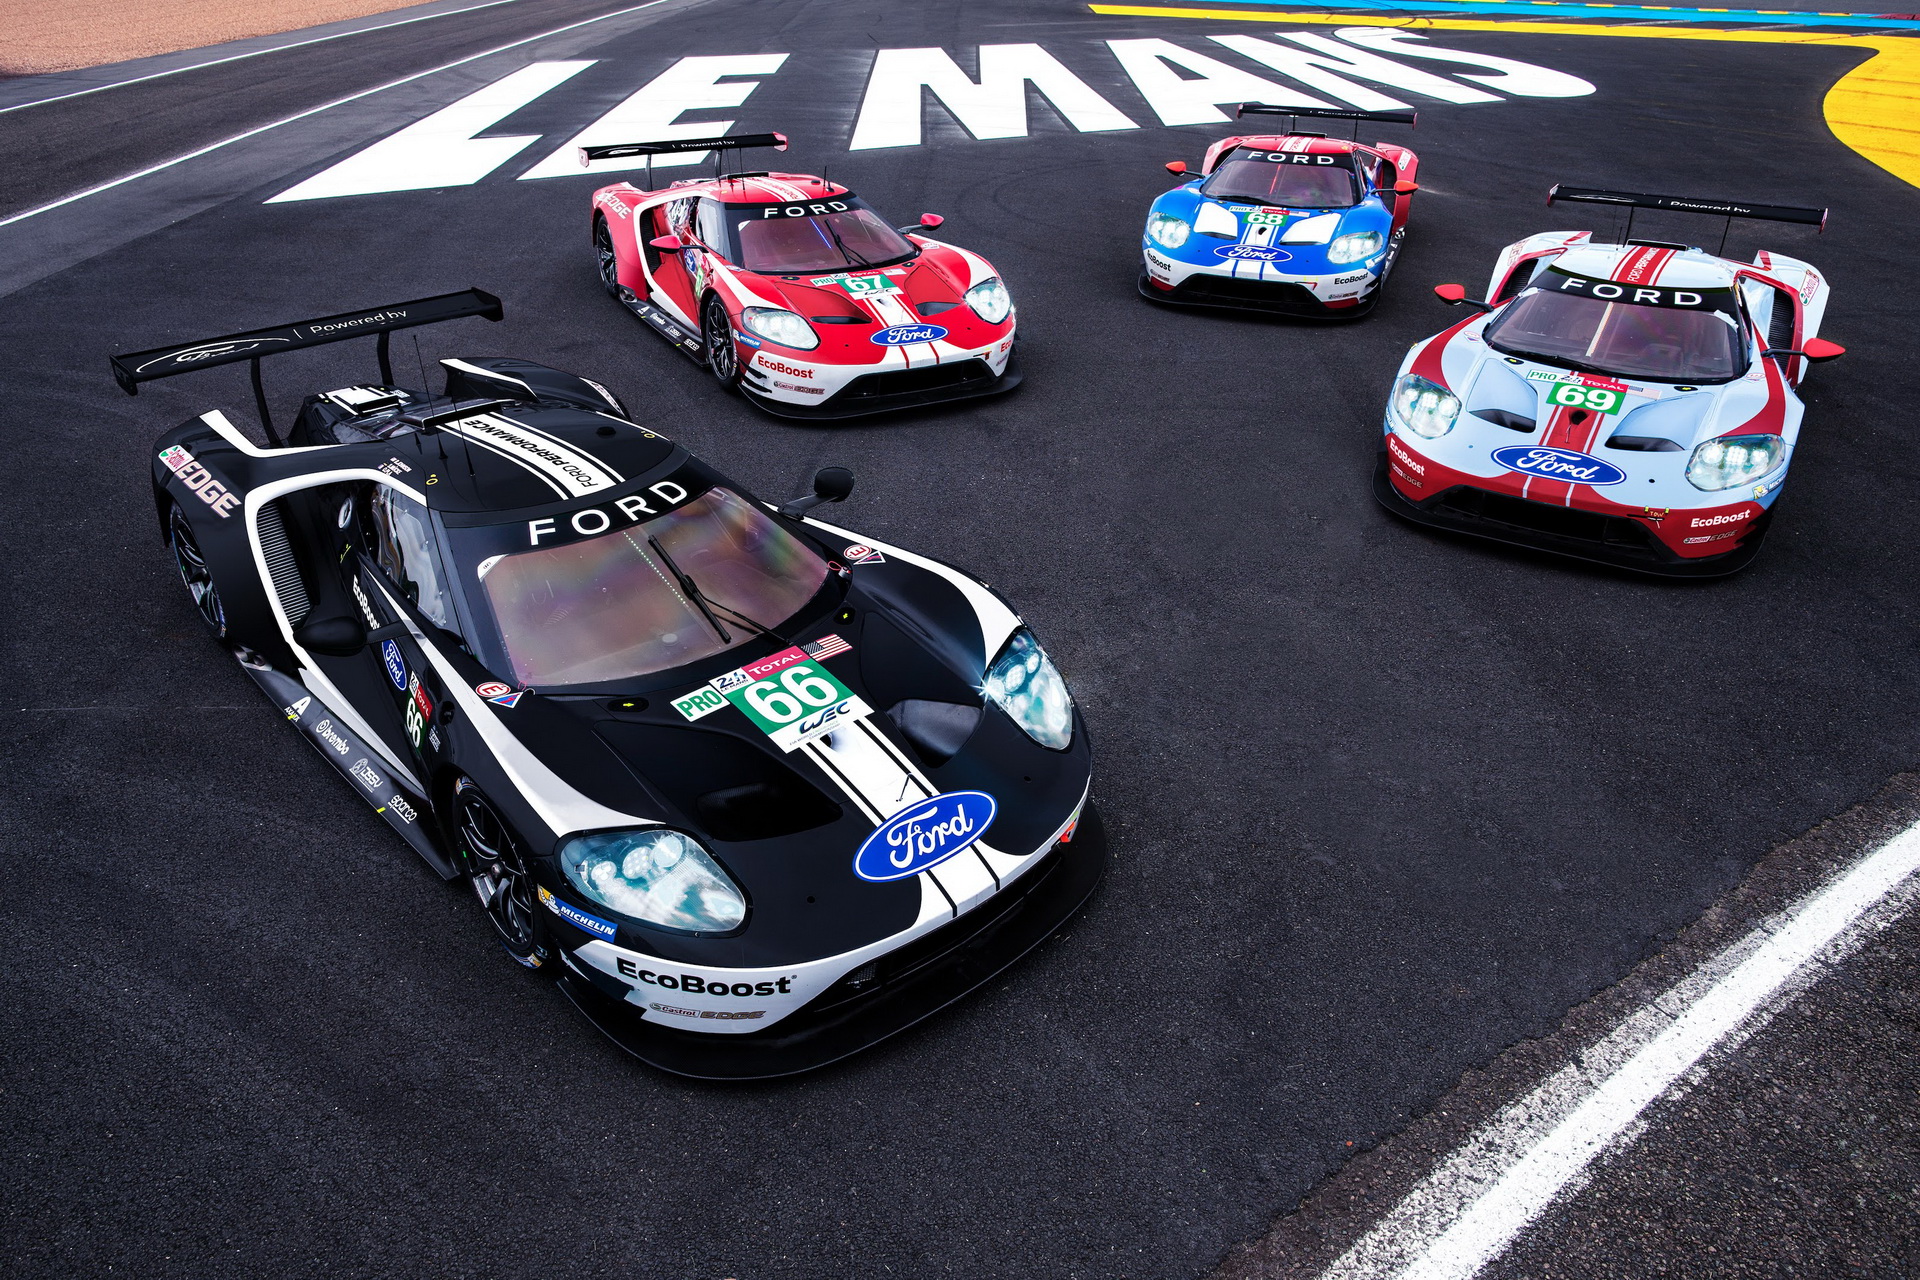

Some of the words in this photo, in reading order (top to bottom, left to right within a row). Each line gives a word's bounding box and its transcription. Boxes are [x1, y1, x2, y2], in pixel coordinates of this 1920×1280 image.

[263, 53, 790, 204] LE
[849, 27, 1597, 151] MANS
[1247, 152, 1334, 165] FORD
[764, 201, 848, 219] FORD
[1247, 212, 1284, 225] 68
[1228, 246, 1278, 260] Ford
[845, 275, 884, 291] 67
[1560, 278, 1702, 306] FORD
[310, 313, 385, 334] Powered
[887, 326, 934, 343] Ford
[758, 355, 814, 379] EcoBoost
[1530, 371, 1557, 380] PRO
[1556, 384, 1616, 410] 69
[1585, 379, 1625, 391] TOTAL
[464, 419, 570, 466] PERFORMANCE
[1390, 437, 1425, 476] EcoBoost
[1516, 449, 1600, 480] Ford
[174, 461, 242, 518] EDGE
[562, 465, 598, 488] FORD
[529, 481, 688, 546] FORD
[1690, 509, 1750, 528] EcoBoost
[749, 653, 803, 675] TOTAL
[676, 689, 723, 717] PRO
[744, 665, 839, 724] 66
[407, 697, 423, 748] 66
[799, 701, 850, 734] WEC
[321, 725, 350, 755] brembo
[390, 795, 417, 821] sparco
[887, 803, 974, 869] Ford
[561, 905, 616, 935] MICHELIN
[662, 1005, 697, 1016] Castrol
[700, 1010, 767, 1020] EDGE
